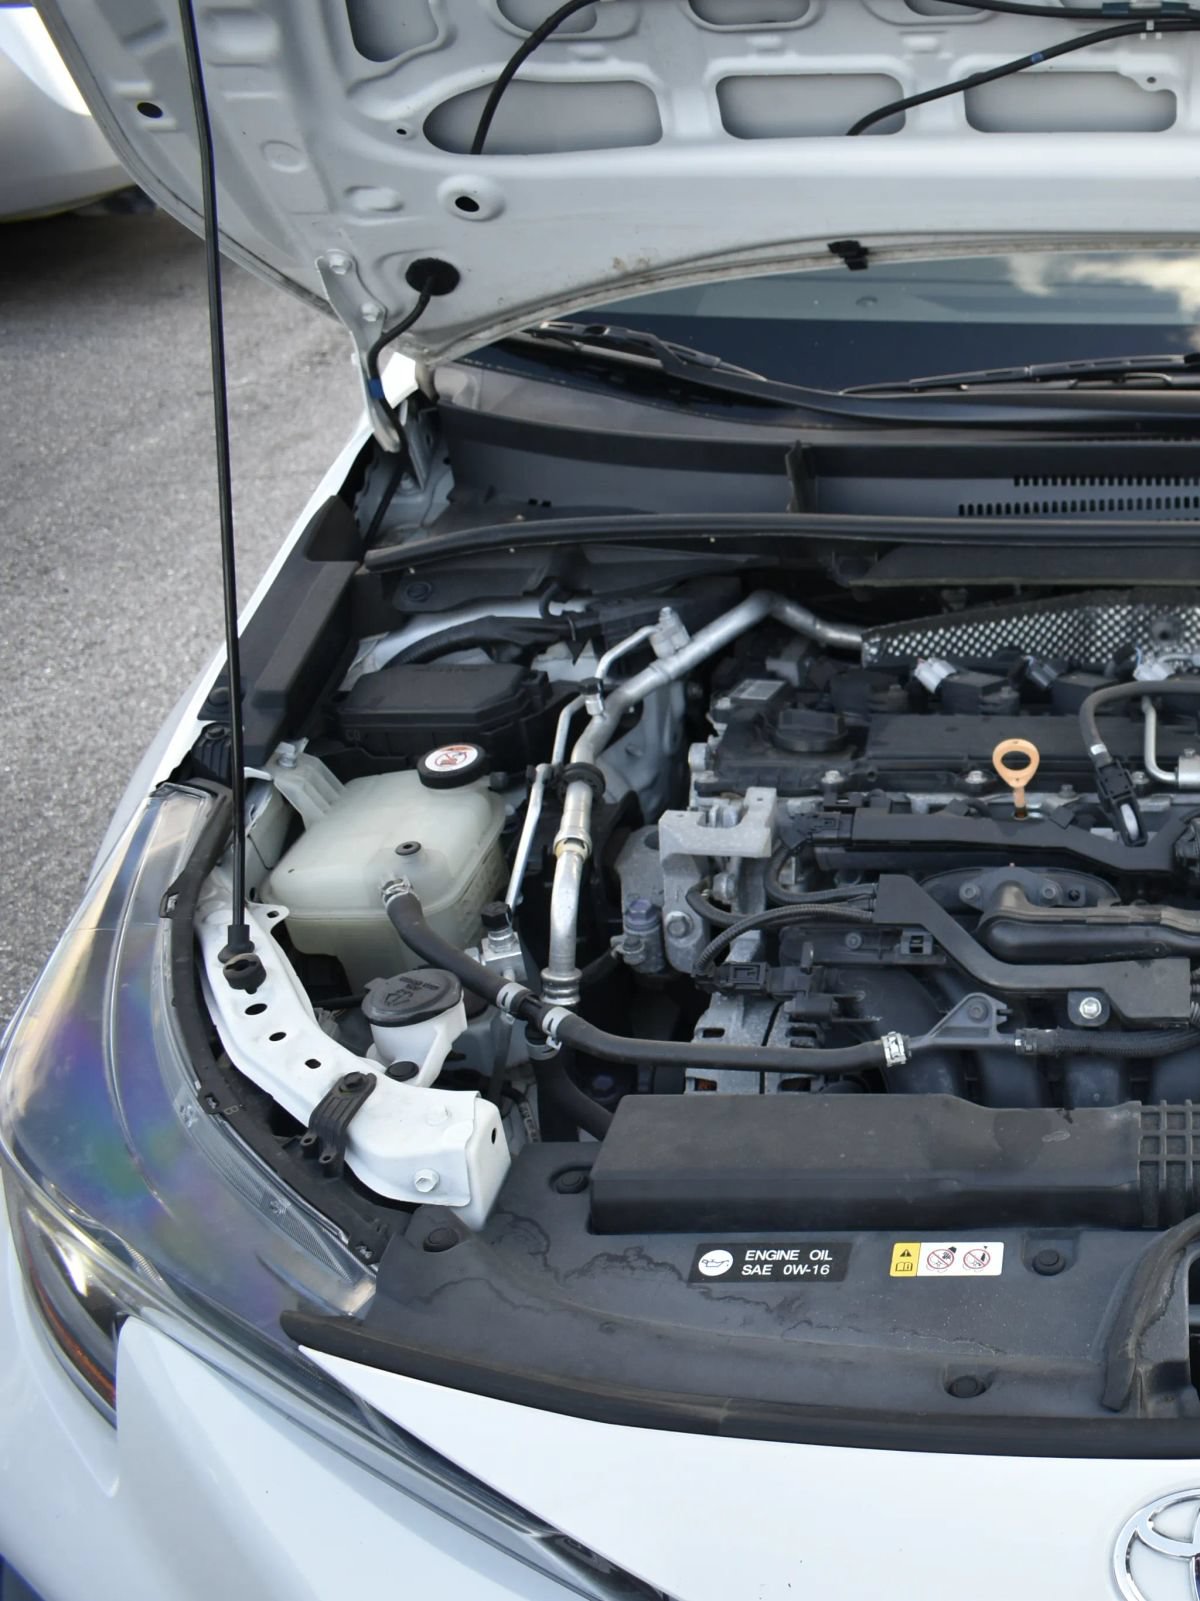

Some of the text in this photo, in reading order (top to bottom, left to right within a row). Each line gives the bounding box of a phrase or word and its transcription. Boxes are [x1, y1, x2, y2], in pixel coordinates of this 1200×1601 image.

[744, 1249, 834, 1261] ENGINE OIL
[741, 1263, 831, 1276] SAE 0W-16
